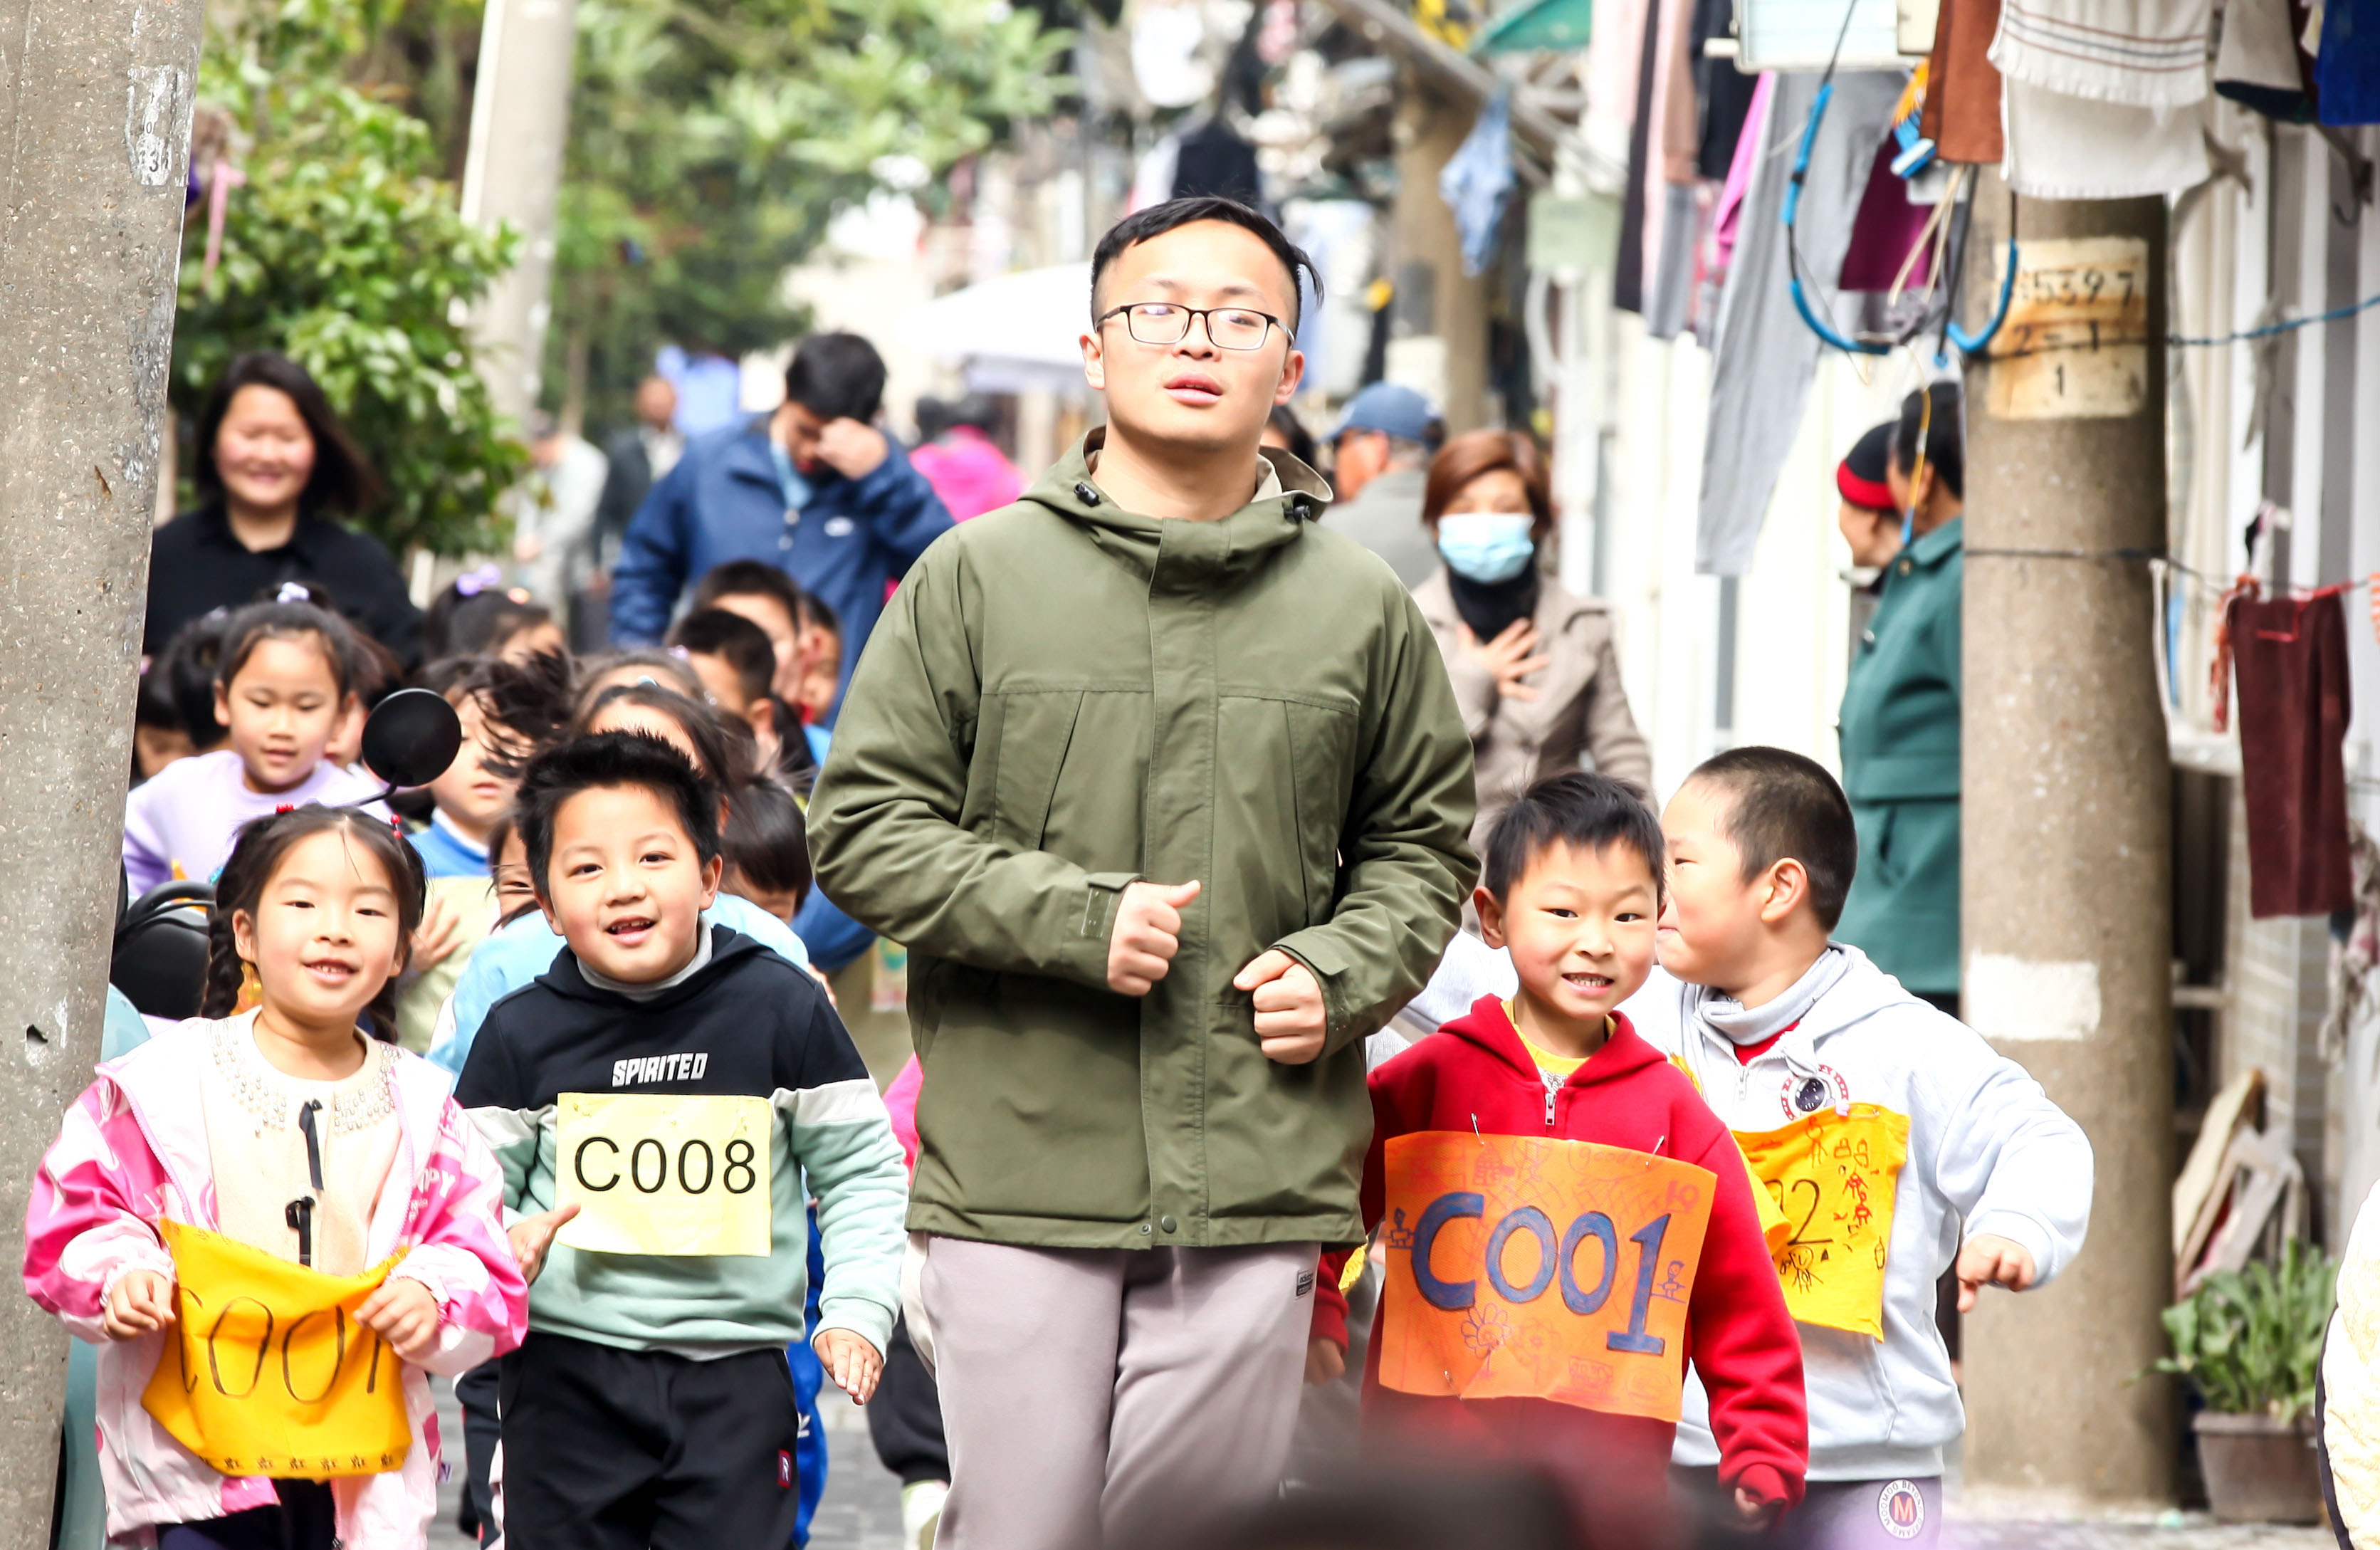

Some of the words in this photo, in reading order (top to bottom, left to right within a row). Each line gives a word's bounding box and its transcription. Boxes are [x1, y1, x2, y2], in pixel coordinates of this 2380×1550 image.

[612, 1053, 708, 1087] SPIRITED
[574, 1137, 756, 1194] C008
[1411, 1192, 1671, 1356] C001
[1893, 1495, 1914, 1522] M
